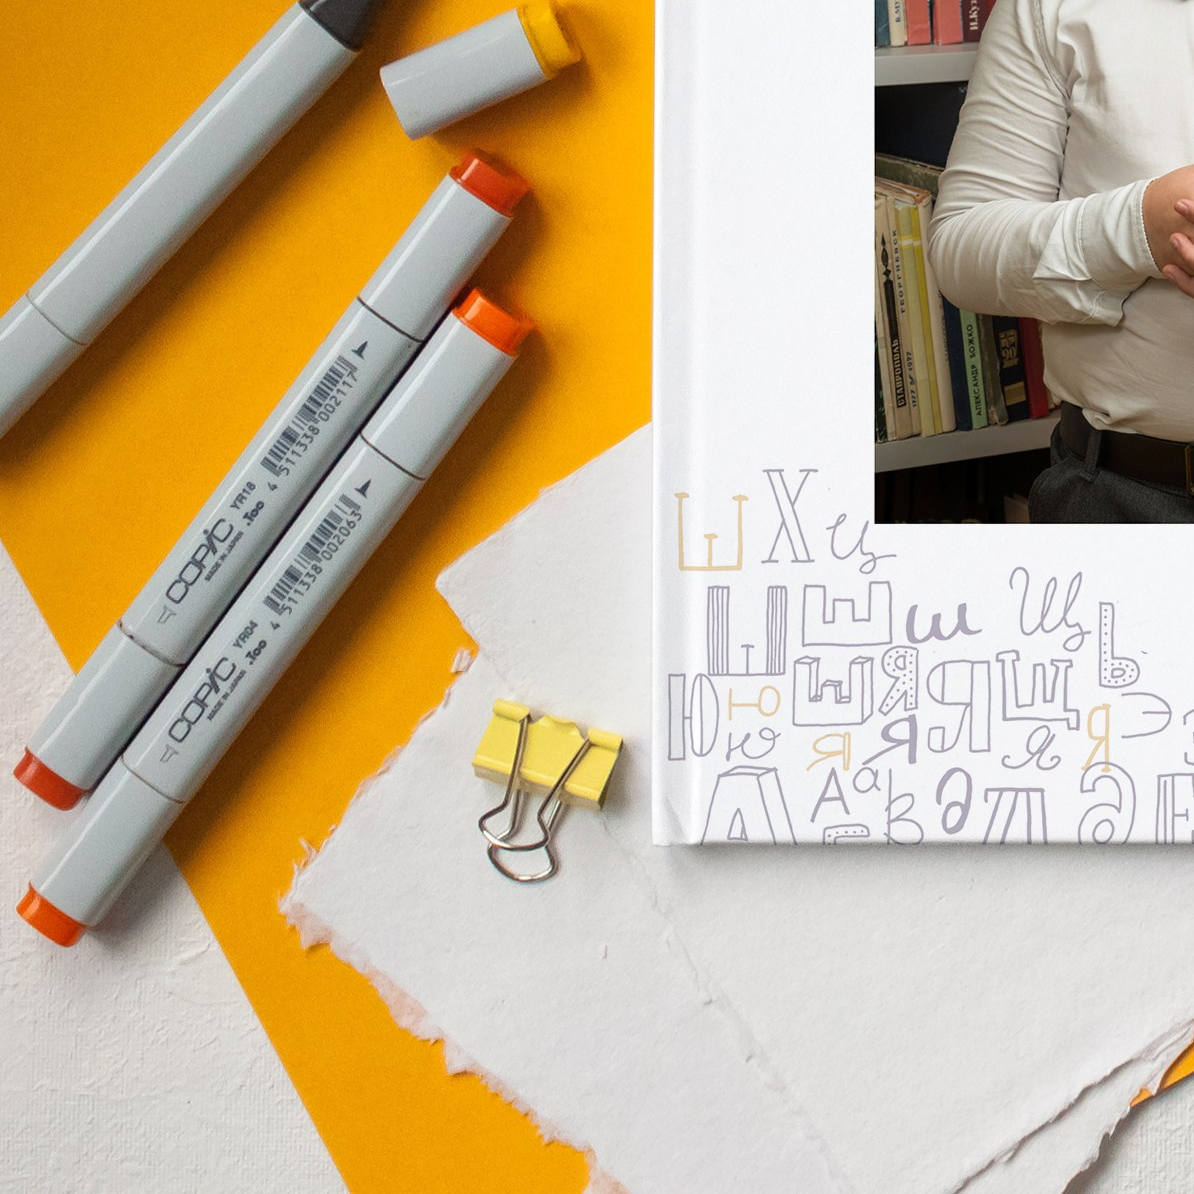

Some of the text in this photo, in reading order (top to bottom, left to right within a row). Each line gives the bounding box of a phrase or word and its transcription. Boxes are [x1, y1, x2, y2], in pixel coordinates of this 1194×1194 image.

[891, 229, 905, 314] ГЕОРГИЕВСК
[890, 339, 905, 407] СТАВРОПОЛЬ
[966, 323, 982, 417] АЛЕКСАНДР БОЖКО
[278, 426, 320, 476] 511338
[320, 372, 358, 423] 002117
[230, 481, 257, 511] YR18
[279, 564, 323, 615] 511338
[321, 511, 362, 562] 002063
[232, 620, 258, 650] YR04
